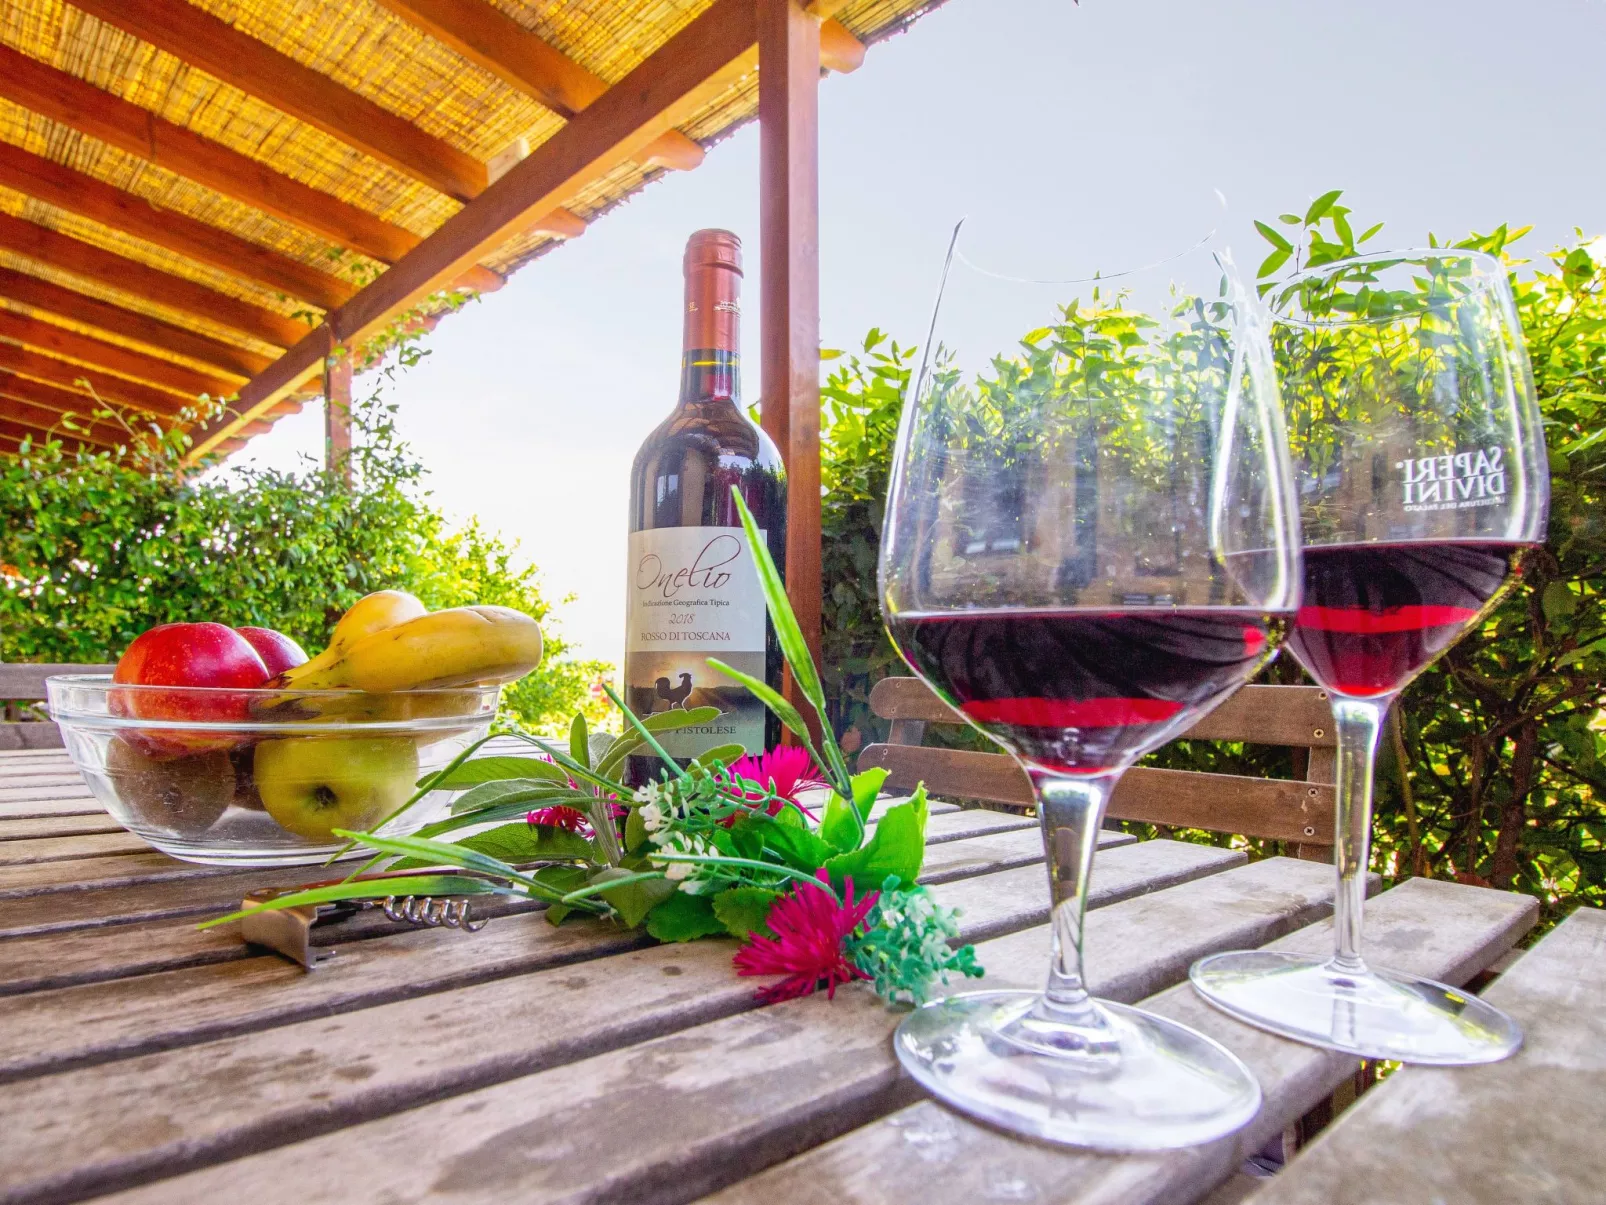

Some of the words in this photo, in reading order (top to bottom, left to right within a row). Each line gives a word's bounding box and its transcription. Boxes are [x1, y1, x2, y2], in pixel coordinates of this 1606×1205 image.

[636, 534, 741, 598] Onelio
[673, 599, 708, 607] Geografica
[709, 598, 730, 607] Tipica
[668, 613, 696, 624] 2018
[641, 632, 667, 641] ROSSO
[669, 632, 679, 640] DI
[681, 632, 731, 640] TOSCANA
